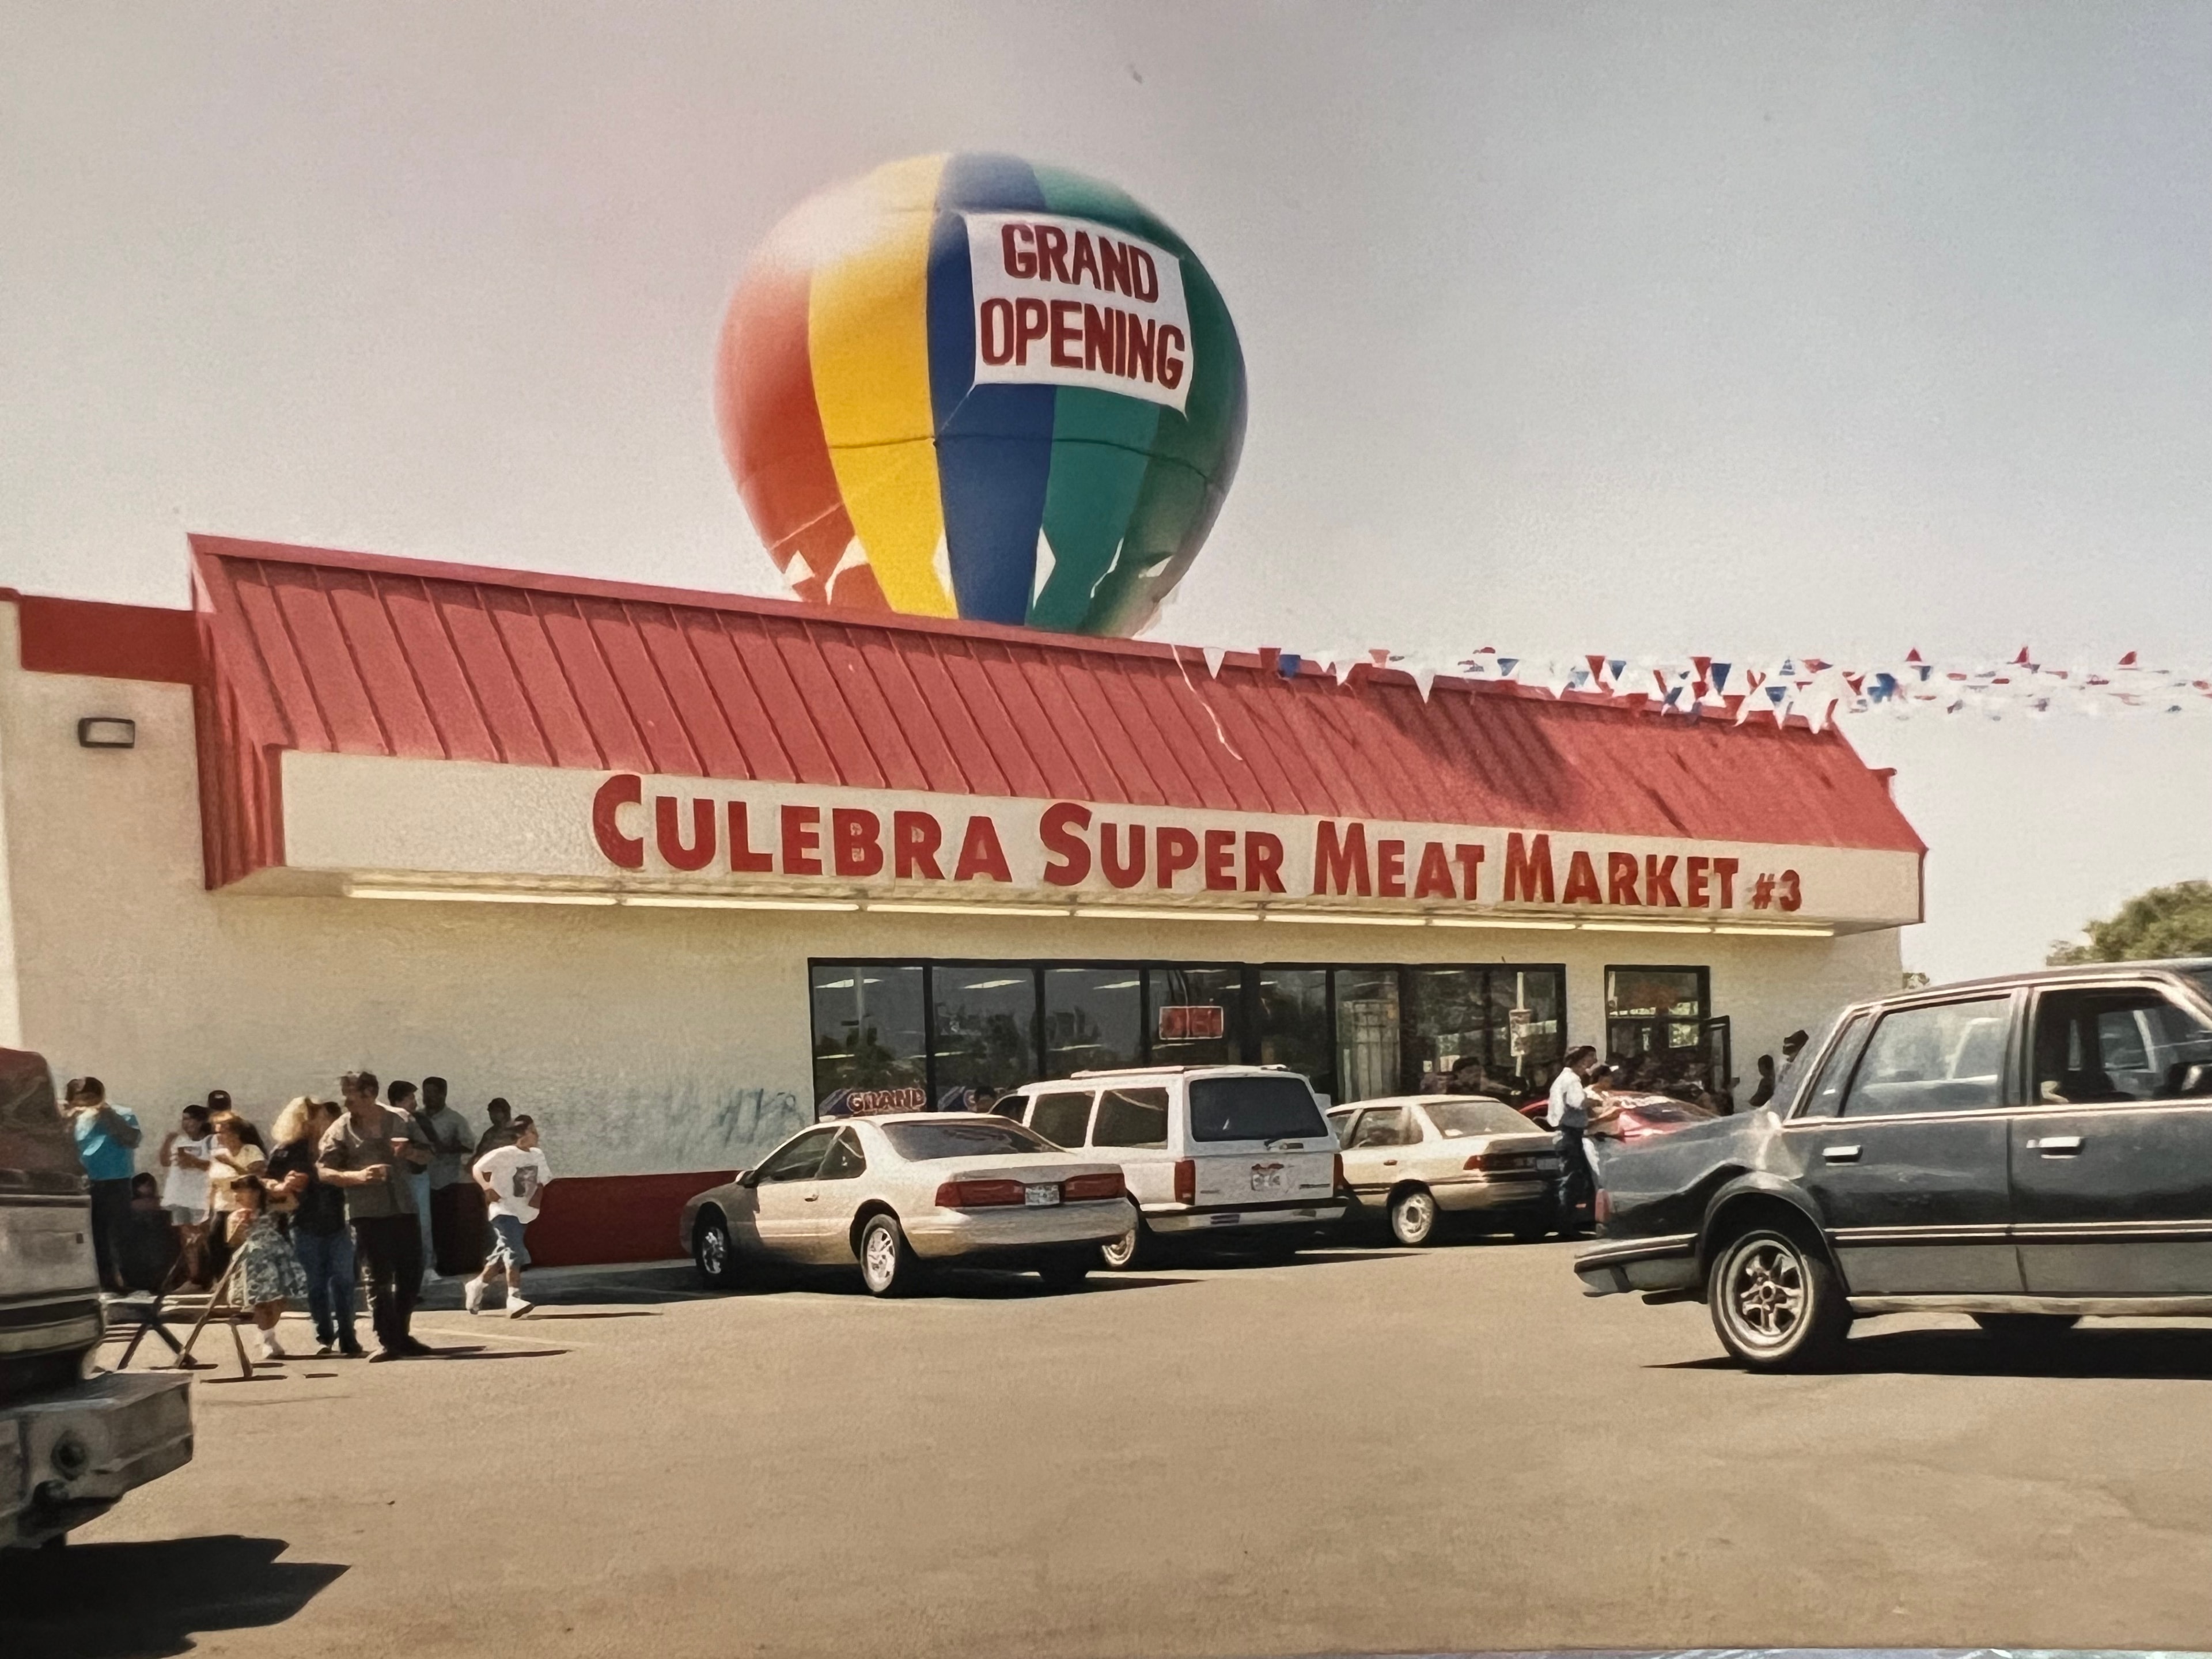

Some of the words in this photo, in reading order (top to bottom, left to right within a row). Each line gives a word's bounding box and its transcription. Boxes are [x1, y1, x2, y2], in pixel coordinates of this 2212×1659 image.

[1001, 224, 1159, 303] GRAND
[980, 297, 1185, 390] OPENING
[592, 774, 1013, 882] CULEBRA
[1039, 802, 1287, 893] SUPER
[1313, 820, 1485, 900] MEAT
[1503, 832, 1739, 909] MARKET
[1751, 869, 1802, 912] #3
